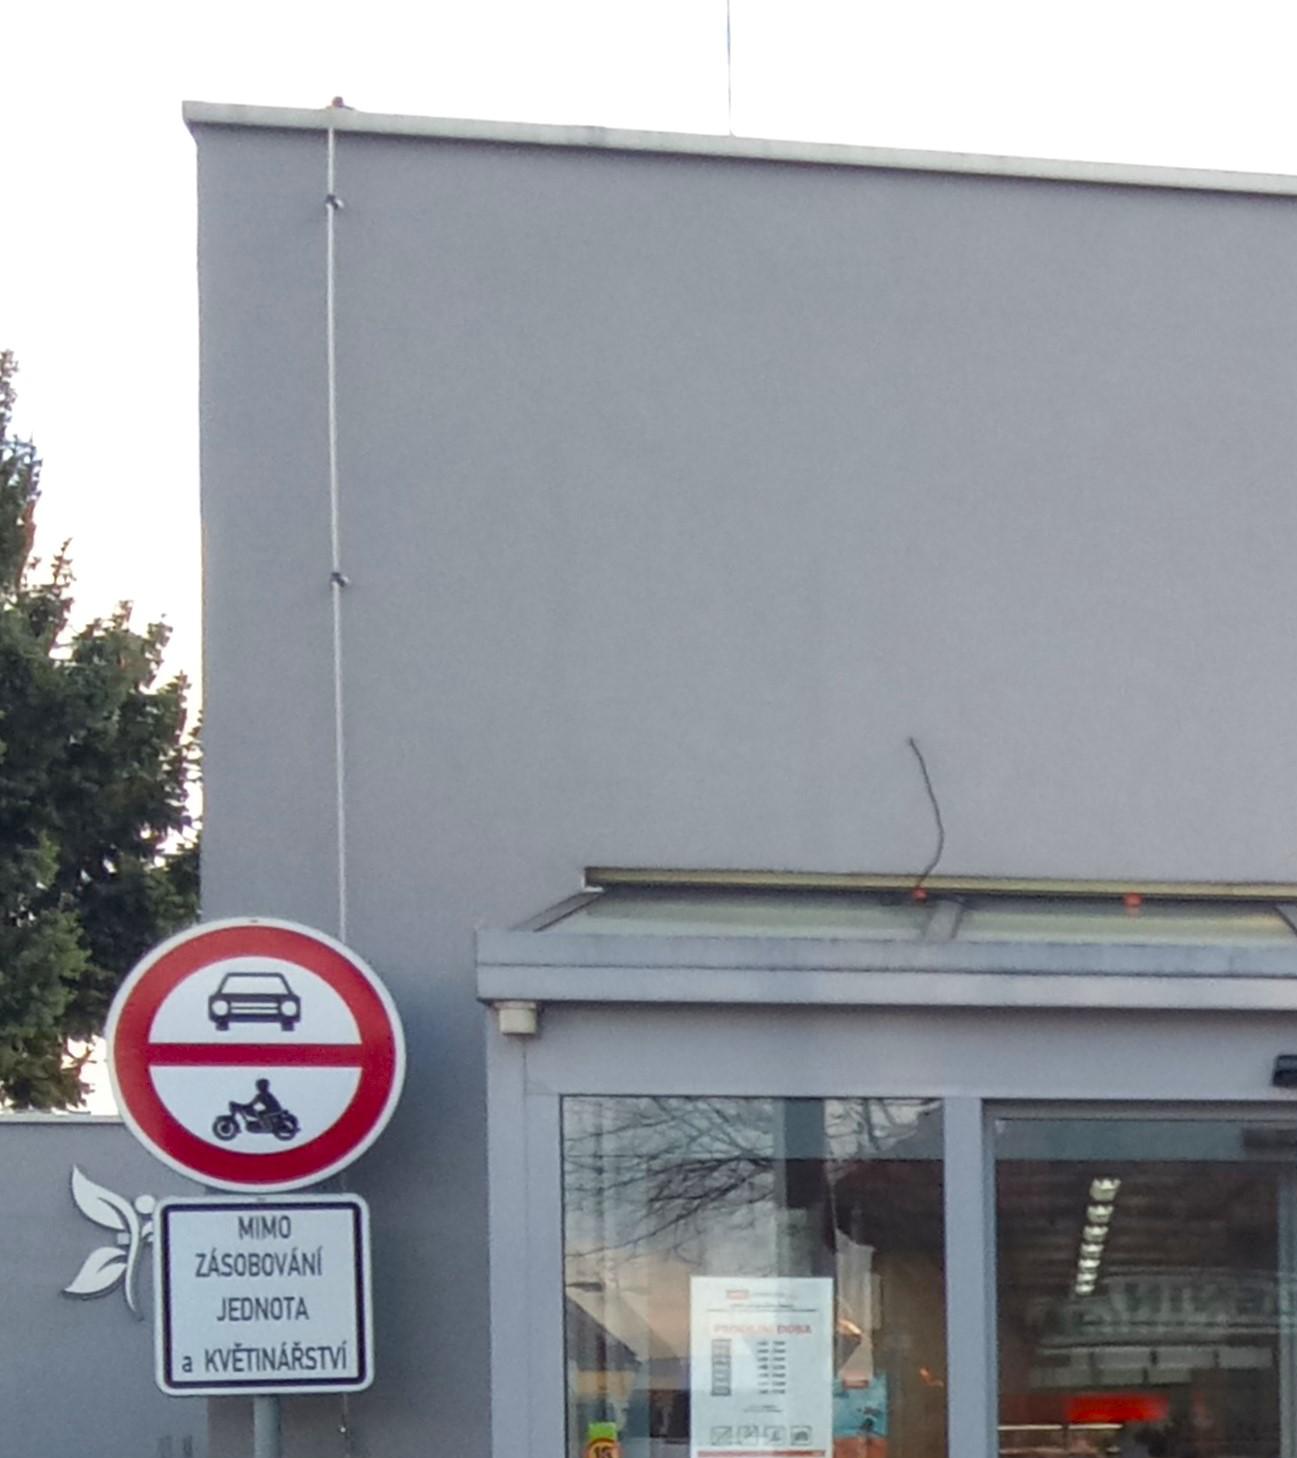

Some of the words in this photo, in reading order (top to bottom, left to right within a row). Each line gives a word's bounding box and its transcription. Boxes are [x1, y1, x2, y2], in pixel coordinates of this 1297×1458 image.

[238, 1215, 292, 1240] MIMO
[194, 1245, 323, 1278] ZÁSOBOVÁNÍ
[216, 1297, 310, 1322] JEDNOTA
[181, 1355, 193, 1373] a
[204, 1340, 348, 1373] KVĚTINÁŘSTVÍ
